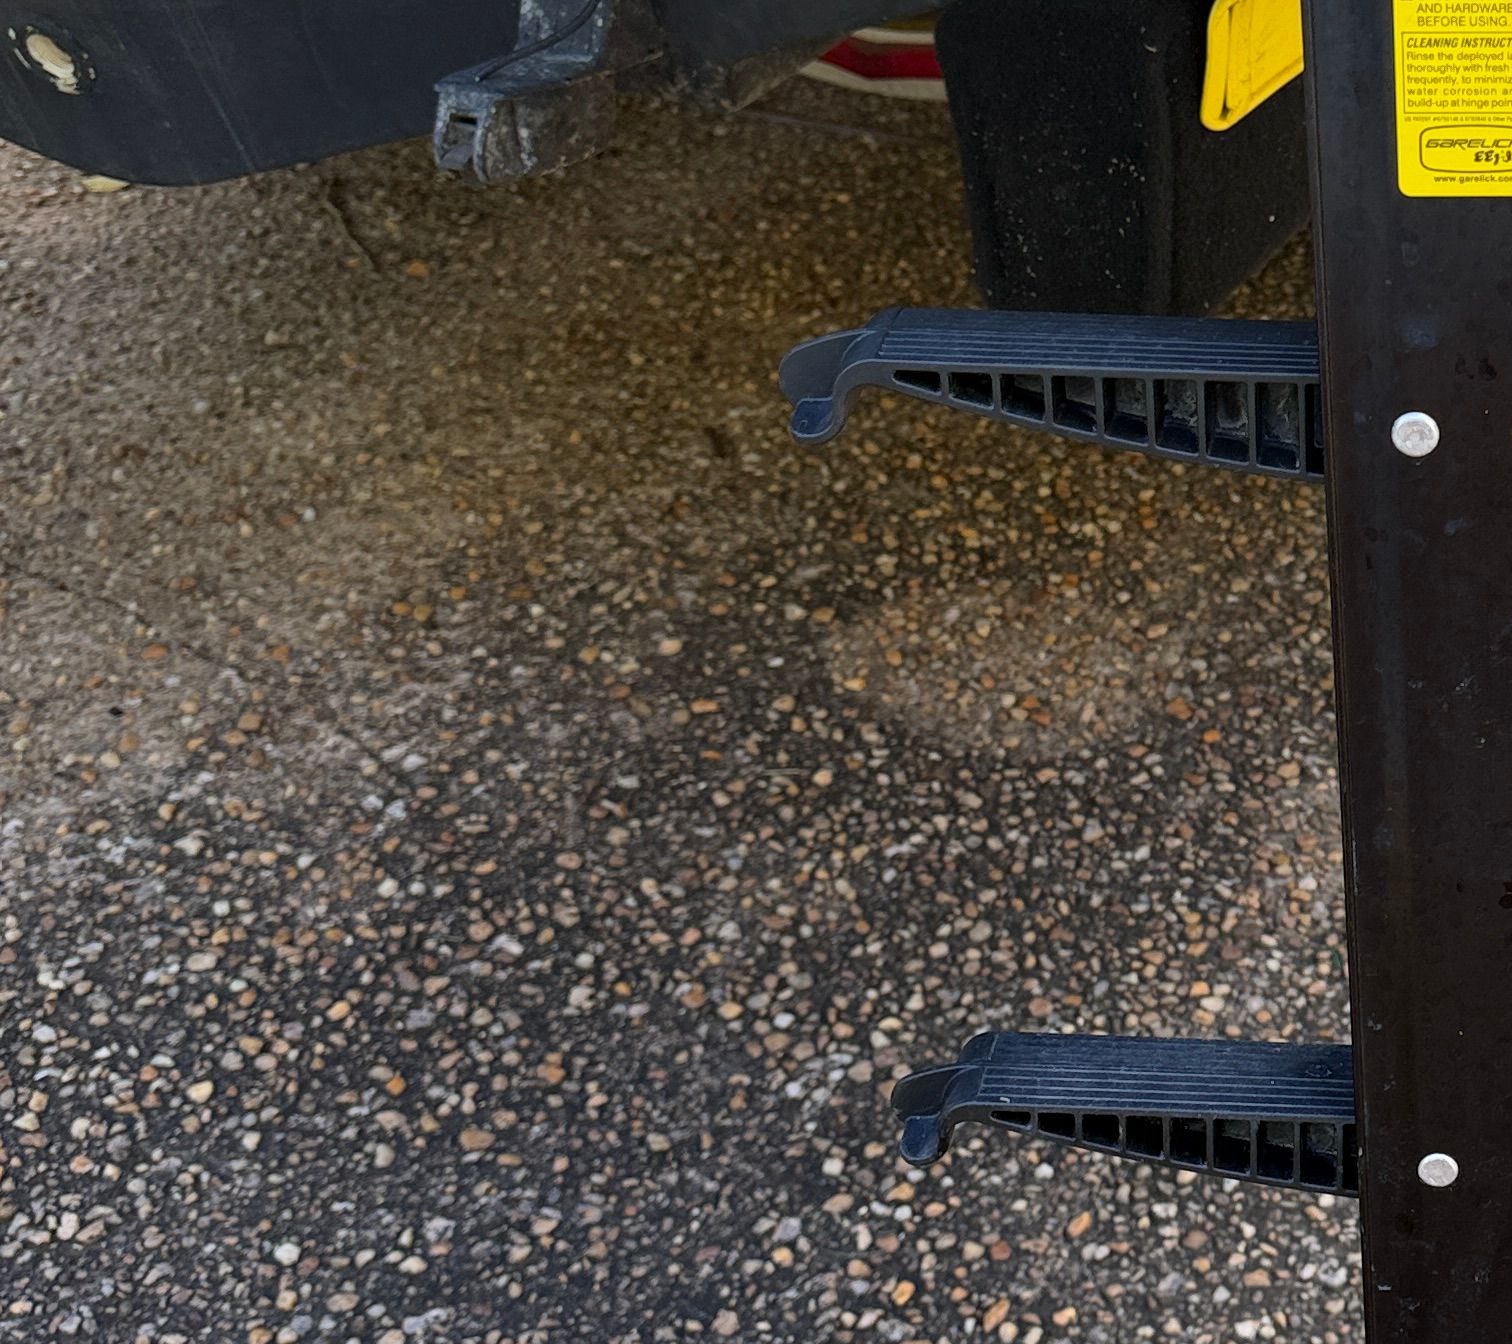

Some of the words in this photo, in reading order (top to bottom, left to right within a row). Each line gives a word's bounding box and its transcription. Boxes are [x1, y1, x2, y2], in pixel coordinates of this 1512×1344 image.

[1416, 3, 1442, 13] AND
[1417, 16, 1466, 27] BEFORE
[1469, 16, 1511, 27] USING.
[1407, 37, 1458, 48] CLEANING
[1407, 52, 1434, 61] Rinse
[1437, 52, 1453, 61] the
[1456, 52, 1504, 64] deployed
[1407, 63, 1461, 75] thoroughly
[1463, 63, 1483, 72] with
[1485, 63, 1510, 72] fresh
[1461, 75, 1472, 84] to
[1407, 87, 1438, 96] water
[1444, 87, 1497, 96] corrosion
[1408, 98, 1448, 110] build-up
[1450, 98, 1461, 107] at
[1461, 98, 1490, 110] hinge
